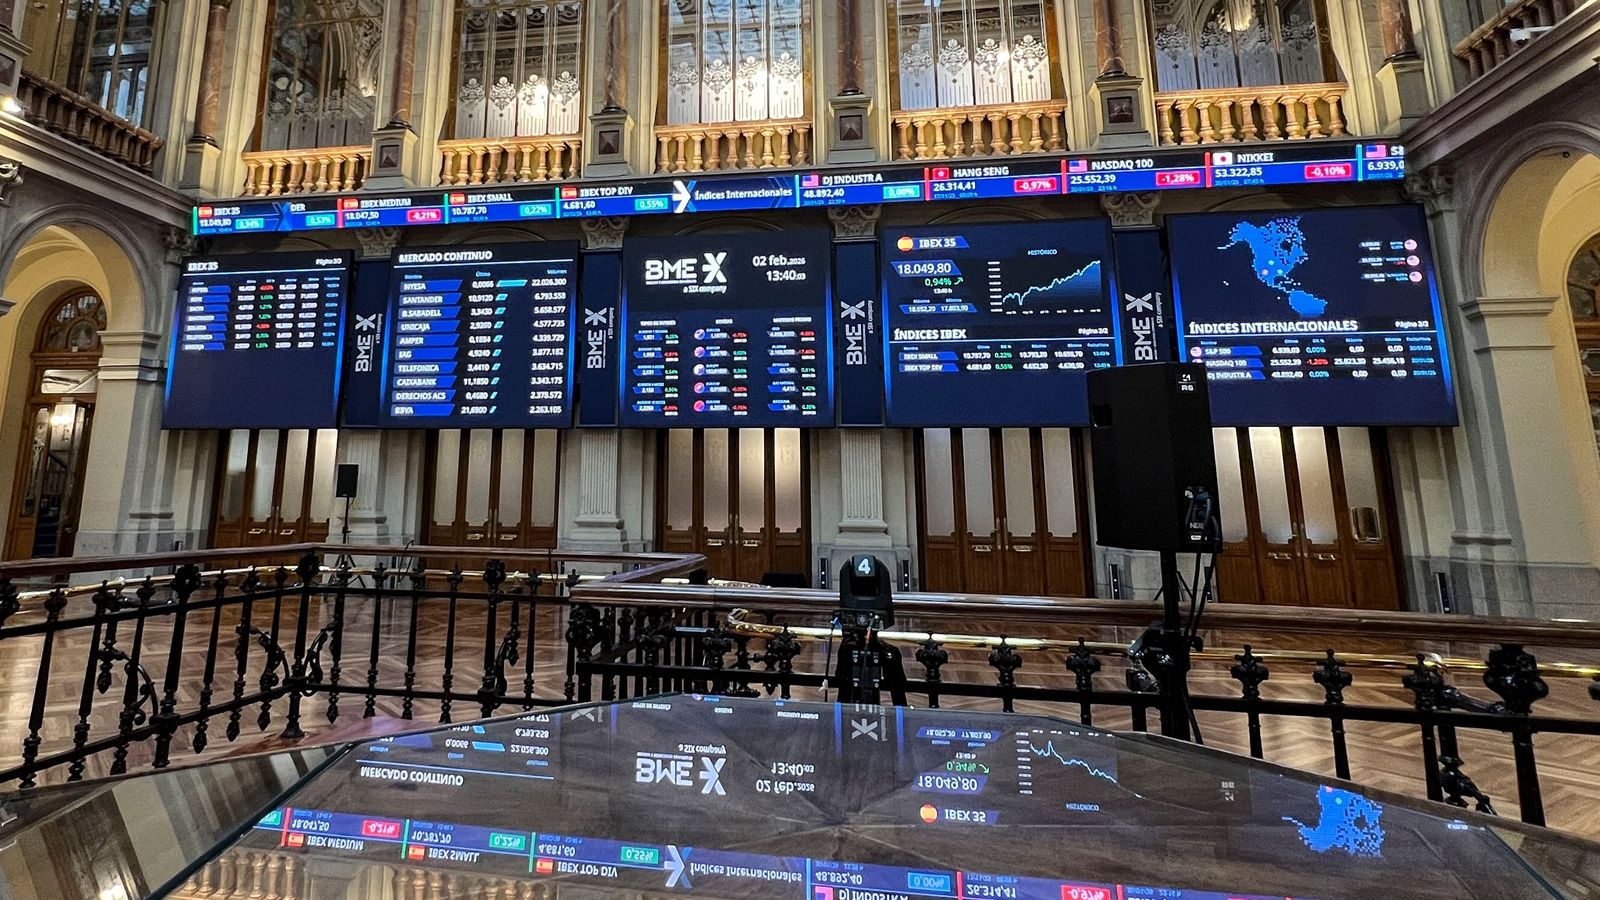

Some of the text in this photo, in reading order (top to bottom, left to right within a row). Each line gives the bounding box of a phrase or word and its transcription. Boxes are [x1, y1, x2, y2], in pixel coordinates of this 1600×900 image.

[1237, 153, 1274, 163] NIKKEI
[1091, 159, 1153, 171] NASDAQ 100
[953, 166, 1009, 178] HANG SENG
[1215, 167, 1345, 178] 53.322,85 -0,10%
[822, 176, 833, 186] DJ
[834, 174, 874, 185] INDUSTR
[1070, 173, 1195, 185] 25.552,39 -1,28%
[933, 181, 1051, 192] 26.314,41 -0,97%
[580, 187, 633, 197] IBEX TOP DIV
[695, 188, 793, 201] Índices Internacionales
[803, 188, 845, 198] 48.892,40
[361, 198, 411, 208] IBEX MEDIUM
[467, 193, 513, 203] IBEX SMALL
[290, 204, 306, 212] DER
[563, 200, 664, 210] 4.681,60 0,55%
[412, 211, 437, 220] -0,21%
[452, 206, 548, 215] 10.787,70 0,22%
[919, 238, 956, 248] IBEX 35
[399, 250, 493, 263] MERCADO CONTINUO
[752, 254, 806, 267] 02 feb.2026
[645, 258, 697, 280] BME
[898, 262, 952, 275] 18.049,80
[924, 277, 952, 287] 0,94%
[688, 285, 699, 293] SIX
[699, 285, 727, 294] company
[403, 296, 443, 304] SANTANDER
[402, 309, 441, 318] B.SABADELL
[401, 322, 430, 331] UNICAJA
[1189, 320, 1358, 334] ÍNDICES INTERNACIONALES
[894, 328, 967, 340] ÍNDICES IBEX
[1131, 317, 1154, 361] BME
[587, 330, 603, 369] BME
[845, 324, 863, 365] BME
[355, 334, 371, 372] BME
[398, 364, 440, 372] TELEFONICA
[396, 378, 436, 386] CAIXABANK
[396, 392, 432, 400] DERECHOS
[432, 392, 446, 400] ACS
[858, 558, 871, 574] 4
